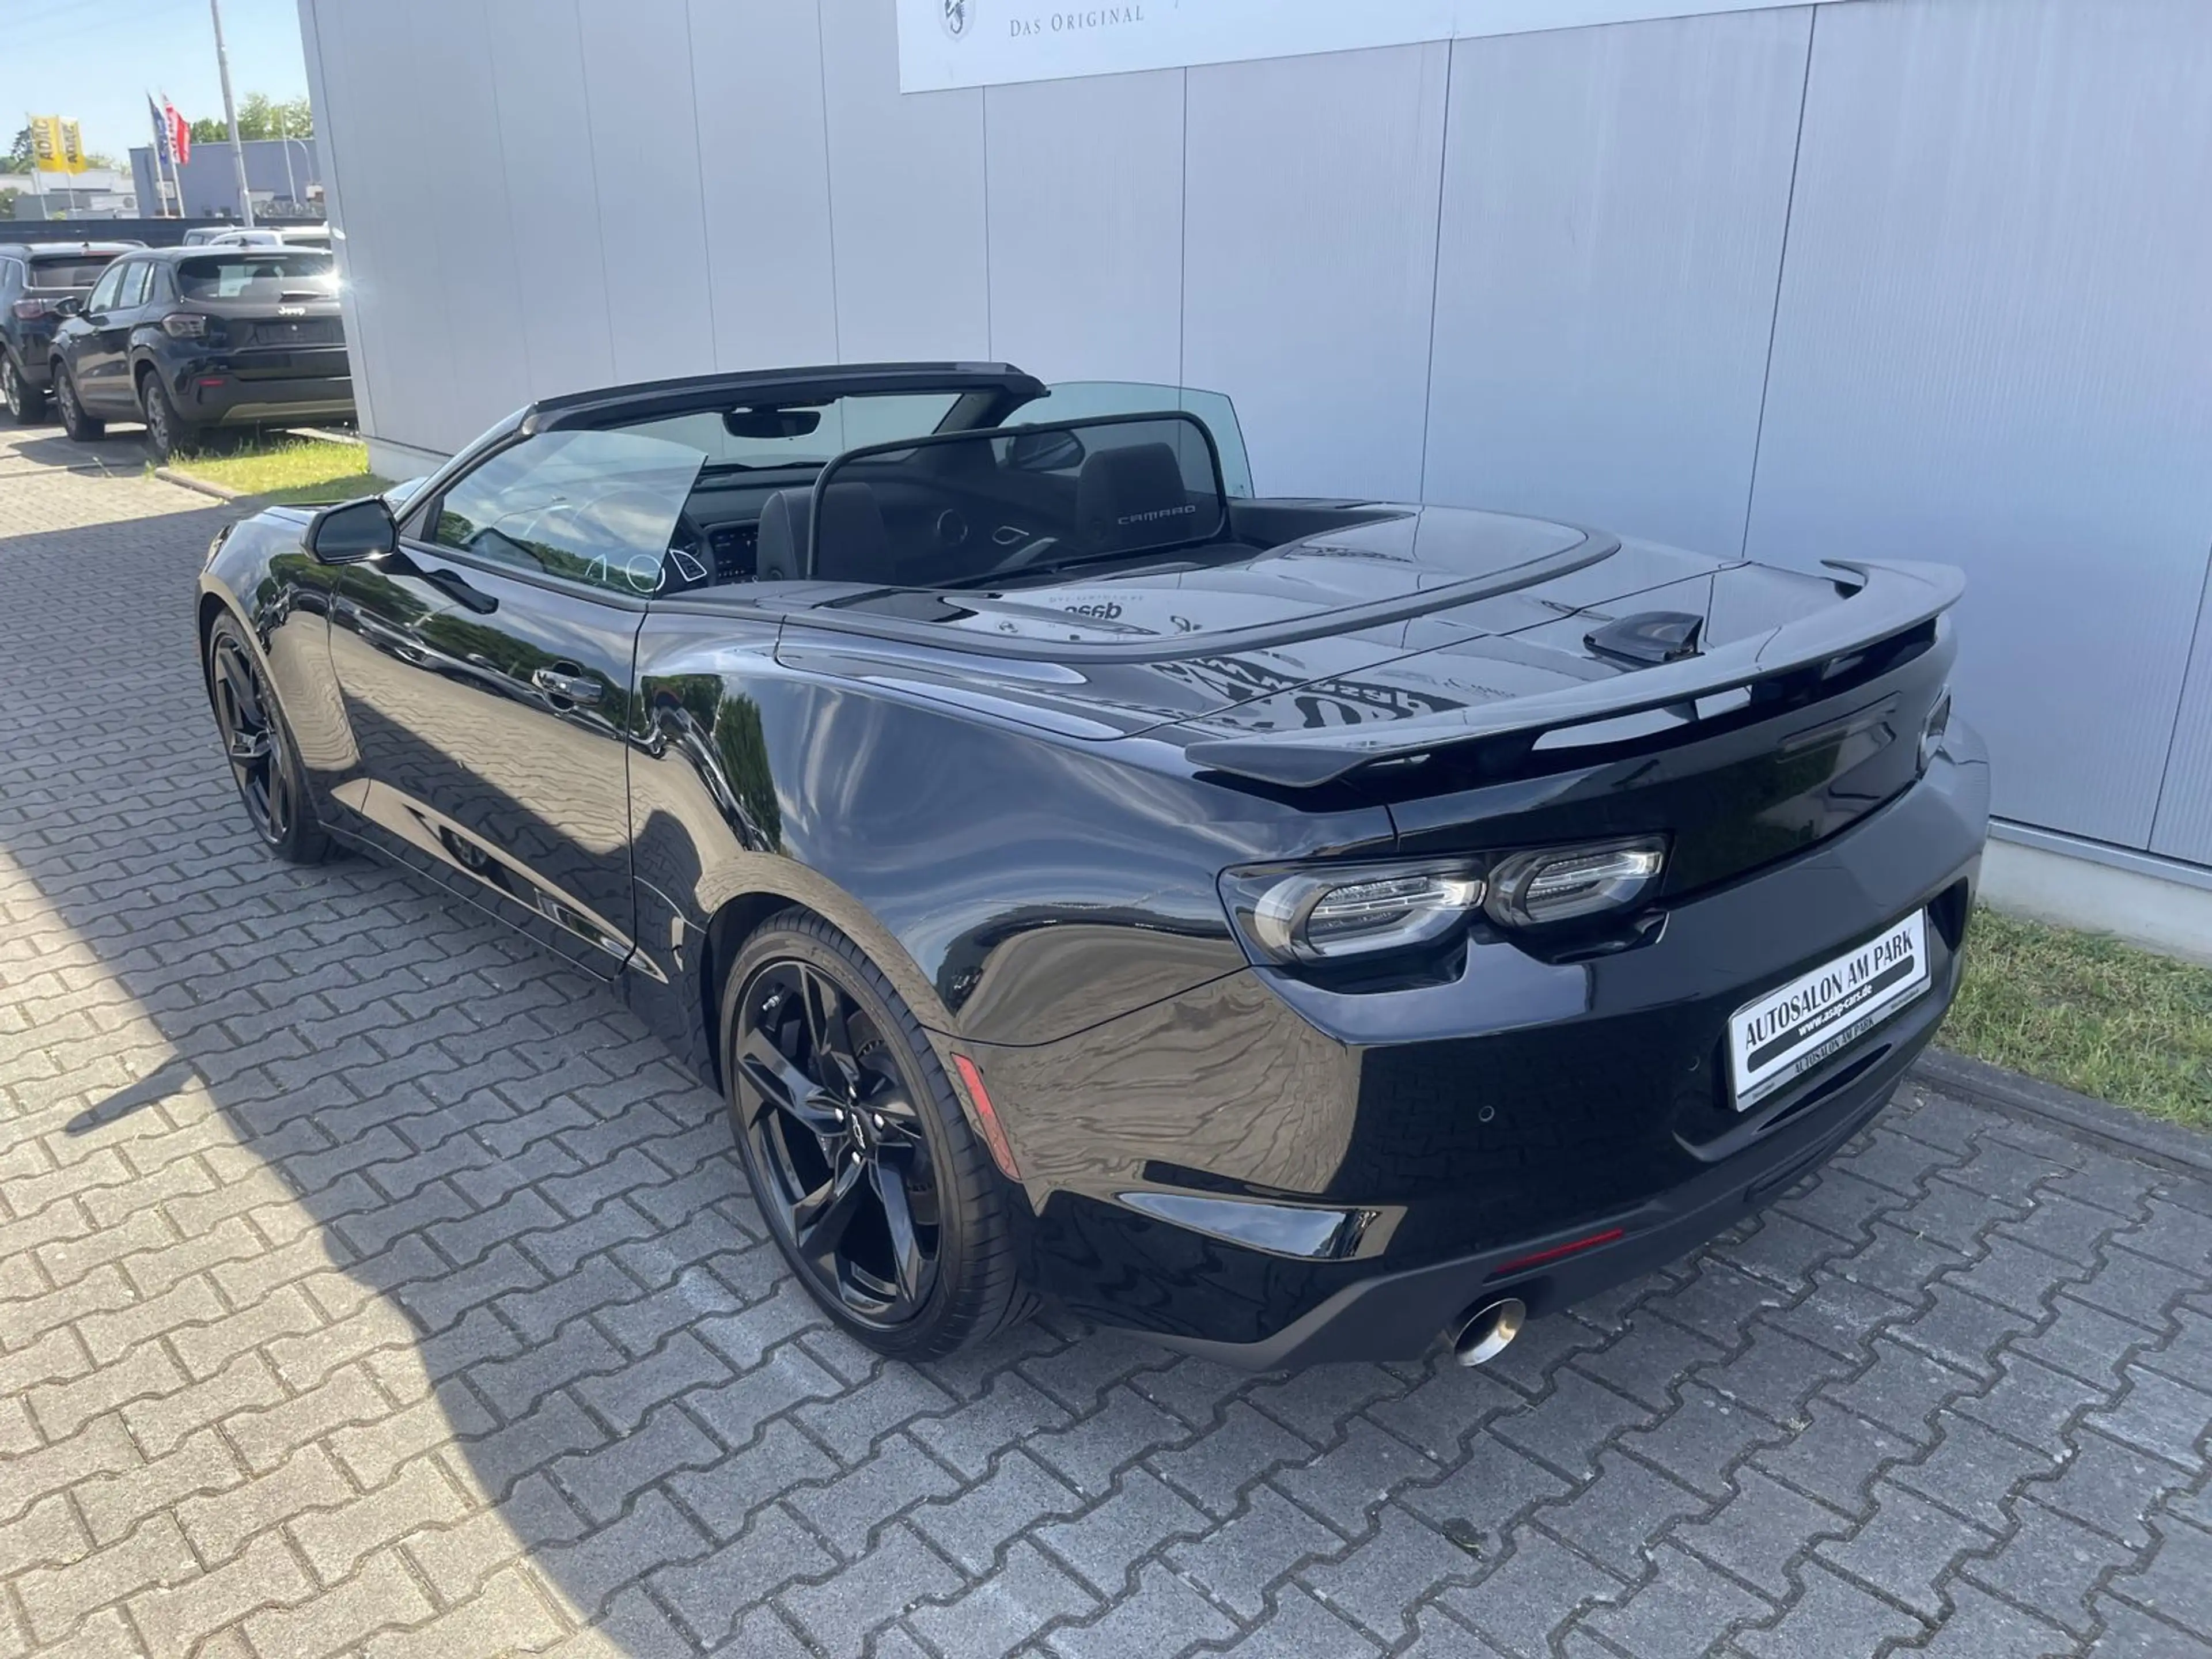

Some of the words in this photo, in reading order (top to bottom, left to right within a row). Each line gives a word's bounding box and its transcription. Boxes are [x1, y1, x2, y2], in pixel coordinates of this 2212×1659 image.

[1010, 18, 1041, 37] DAS
[1051, 5, 1144, 32] ORIGINAL
[1118, 504, 1196, 525] CAMARO
[1746, 970, 1843, 1049] AUTOSALON
[1847, 953, 1870, 987] AM
[1874, 927, 1914, 971] PARK
